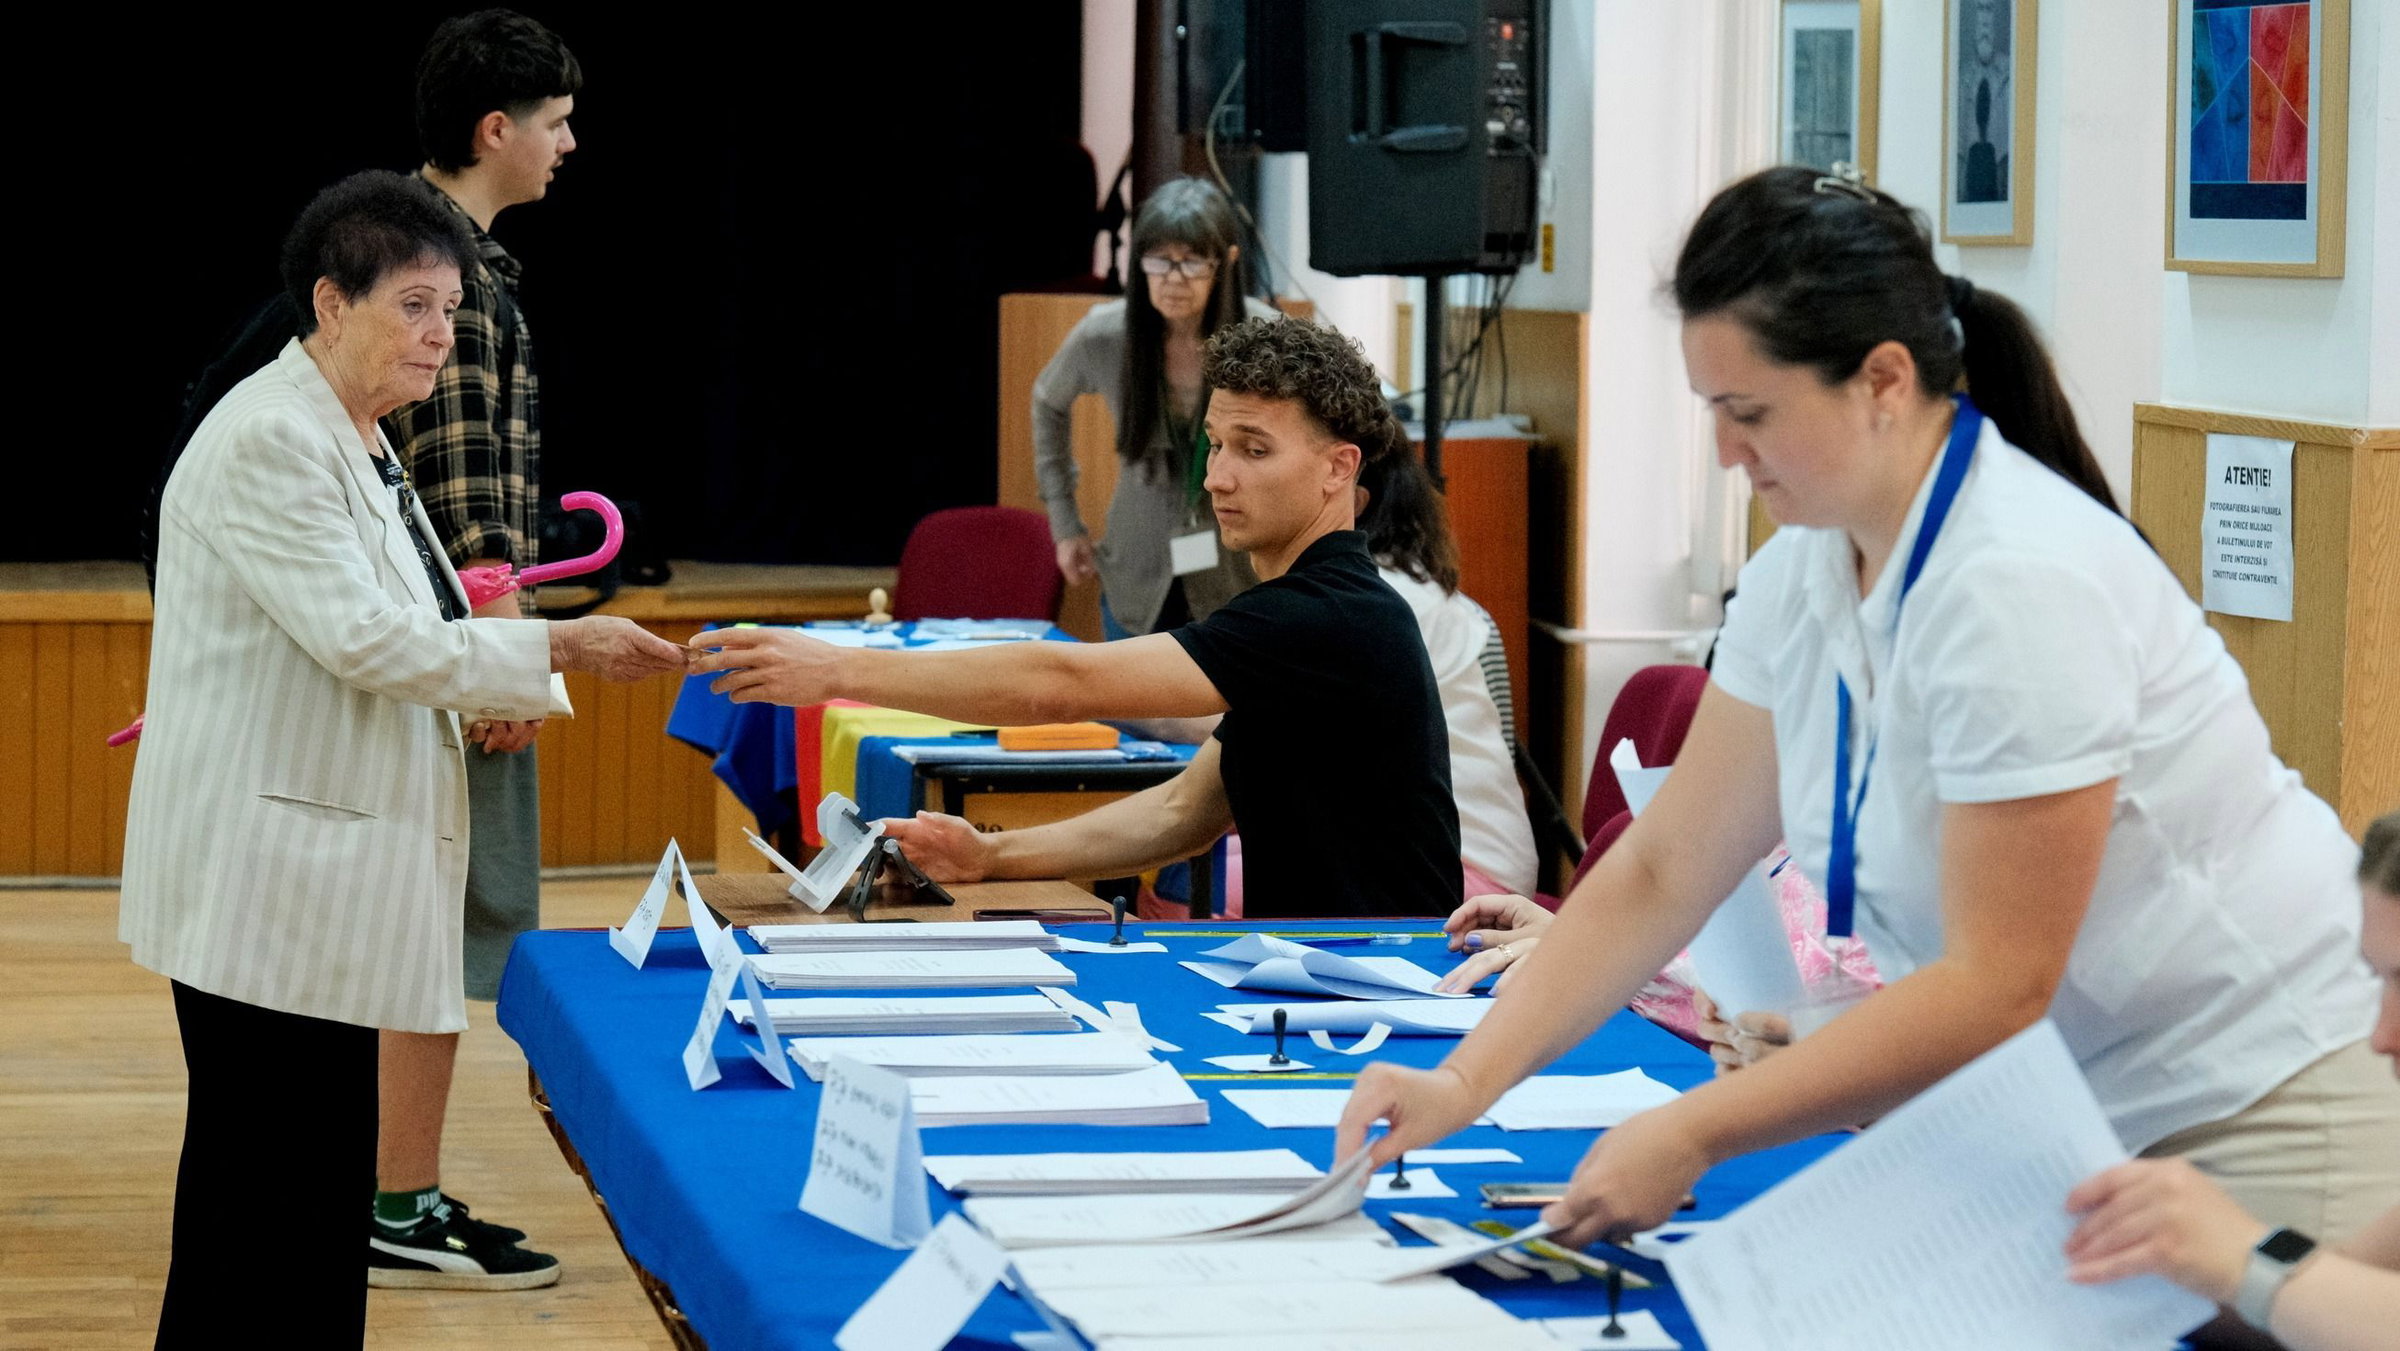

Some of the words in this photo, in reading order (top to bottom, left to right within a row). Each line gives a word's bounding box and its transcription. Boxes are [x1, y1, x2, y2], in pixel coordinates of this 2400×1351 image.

[2224, 466, 2271, 492] ATENȚIE!
[2210, 502, 2250, 513] FOTOGRAFIEREA
[2250, 504, 2260, 514] SAU
[2219, 520, 2231, 528] PRIN
[2232, 520, 2248, 530] ORICE
[2249, 522, 2272, 532] MIJLOACE
[2221, 536, 2256, 548] BULETINULUI
[2256, 540, 2263, 548] DE
[2264, 541, 2272, 549] VOT
[2221, 553, 2233, 563] ESTE
